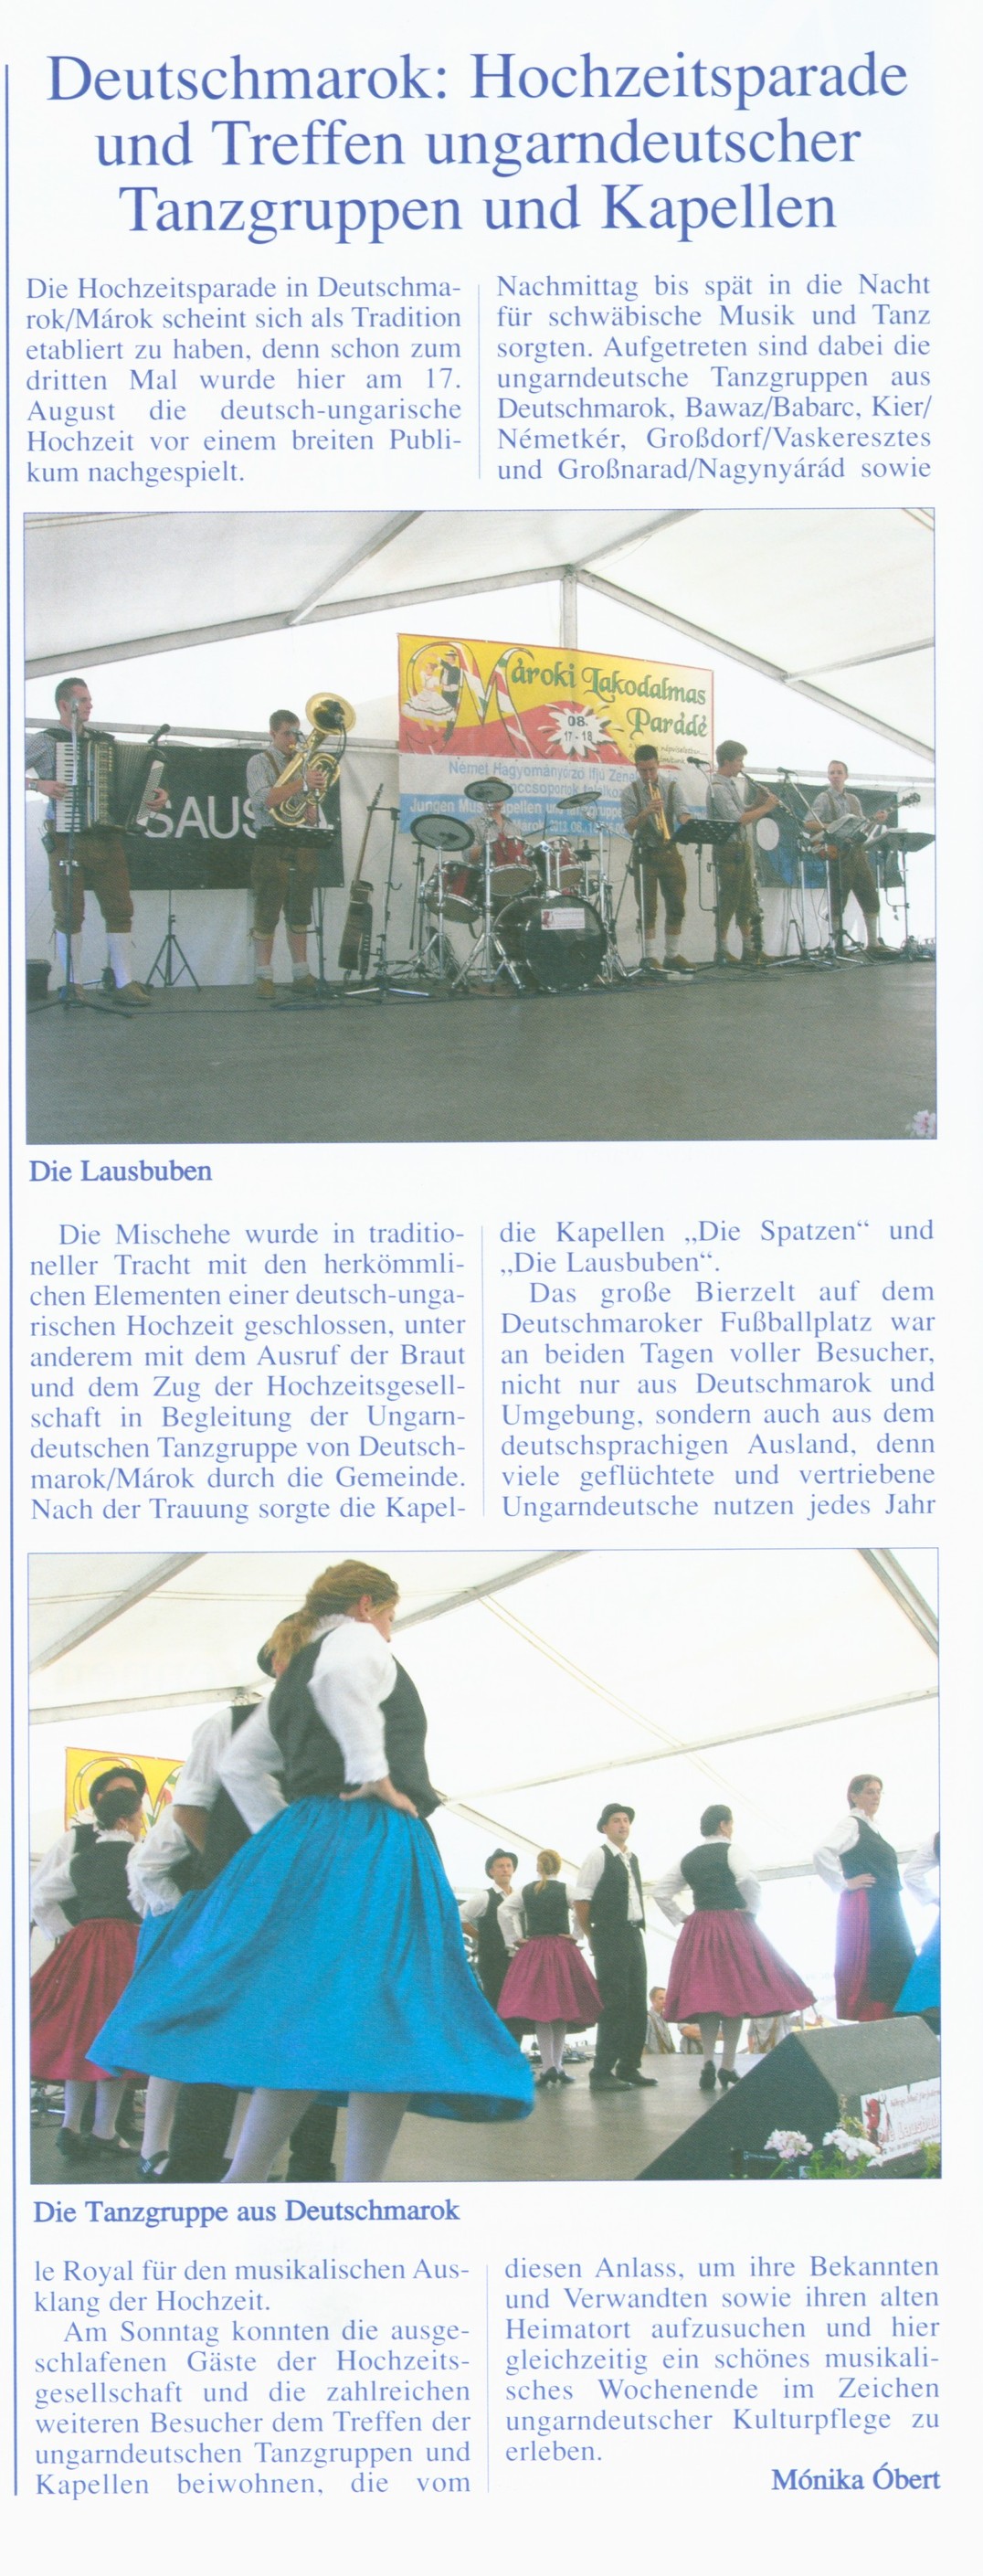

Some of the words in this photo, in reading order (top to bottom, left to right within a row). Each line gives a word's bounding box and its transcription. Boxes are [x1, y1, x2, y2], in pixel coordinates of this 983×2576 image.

[46, 52, 447, 101] Deutschmarok:
[469, 49, 909, 111] Hochzeitsparade
[94, 119, 195, 167] und
[211, 118, 407, 166] Treffen
[424, 116, 862, 178] ungarndeutscher
[118, 186, 464, 246] Tanzgruppen
[481, 183, 582, 231] und
[600, 182, 838, 243] Kapellen
[26, 277, 69, 300] Die
[77, 276, 277, 304] Hochzeitsparade
[286, 276, 309, 298] in
[317, 275, 461, 298] Deutschma-
[496, 304, 534, 327] für
[548, 304, 703, 327] schwäbische
[718, 303, 796, 326] Musik
[812, 303, 857, 325] und
[872, 303, 931, 325] Tanz
[26, 338, 124, 361] etabliert
[134, 344, 162, 360] zu
[173, 337, 251, 363] haben,
[261, 337, 321, 359] denn
[331, 336, 400, 359] schon
[410, 343, 461, 358] zum
[497, 396, 675, 421] Deutschmarok,
[685, 395, 861, 420] Bawaz/Babarc,
[872, 394, 933, 419] Kier/
[26, 429, 134, 452] Hochzeit
[149, 435, 190, 451] vor
[203, 429, 277, 451] einem
[291, 429, 375, 451] breiten
[389, 428, 462, 451] Publi-
[497, 427, 627, 452] Németkér,
[646, 426, 932, 451] Großdorf/Vaskeresztes
[26, 461, 79, 482] kum
[88, 460, 245, 489] nachgespielt.
[497, 458, 544, 481] und
[557, 456, 846, 485] Großnarad/Nagynyárád
[861, 456, 932, 478] sowie
[581, 667, 707, 705] Lakodalmas
[566, 716, 589, 728] 08.
[28, 1159, 73, 1182] Die
[79, 1159, 214, 1182] Lausbuben
[58, 1223, 101, 1246] Die
[115, 1223, 231, 1246] Mischehe
[244, 1222, 319, 1245] wurde
[333, 1222, 355, 1244] in
[368, 1221, 465, 1244] traditio-
[499, 1221, 536, 1243] die
[555, 1220, 665, 1249] Kapellen
[684, 1219, 741, 1246] „Die
[760, 1219, 870, 1247] Spatzen“
[889, 1218, 935, 1241] und
[29, 1254, 99, 1277] neller
[113, 1253, 191, 1276] Tracht
[207, 1253, 248, 1275] mit
[264, 1253, 307, 1275] den
[323, 1252, 465, 1275] herkömmli-
[500, 1251, 556, 1277] „Die
[565, 1250, 720, 1273] Lausbuben“.
[29, 1315, 116, 1337] rischen
[126, 1313, 235, 1336] Hochzeit
[243, 1313, 395, 1342] geschlossen,
[404, 1316, 467, 1335] unter
[501, 1311, 703, 1334] Deutschmaroker
[720, 1310, 872, 1339] Fußballplatz
[890, 1316, 936, 1331] war
[29, 1436, 150, 1459] deutschen
[156, 1436, 298, 1464] Tanzgruppe
[305, 1441, 351, 1458] von
[358, 1435, 466, 1457] Deutsch-
[30, 1467, 196, 1492] marok/Márok
[206, 1466, 276, 1489] durch
[287, 1466, 323, 1489] die
[335, 1465, 466, 1488] Gemeinde.
[501, 1464, 560, 1487] viele
[579, 1463, 714, 1492] geflüchtete
[735, 1463, 779, 1485] und
[798, 1462, 935, 1485] vertriebene
[502, 1494, 699, 1523] Ungarndeutsche
[713, 1498, 795, 1516] nutzen
[806, 1493, 871, 1521] jedes
[884, 1492, 936, 1515] Jahr
[32, 2200, 78, 2223] Die
[84, 2200, 229, 2229] Tanzgruppe
[236, 2205, 278, 2222] aus
[284, 2198, 461, 2222] Deutschmarok
[34, 2260, 55, 2282] le
[62, 2259, 134, 2287] Royal
[142, 2259, 177, 2281] für
[184, 2259, 227, 2281] den
[234, 2257, 407, 2281] musikalischen
[412, 2258, 470, 2280] Aus-
[504, 2256, 583, 2279] diesen
[594, 2256, 684, 2281] Anlass,
[698, 2262, 736, 2278] um
[749, 2255, 796, 2277] ihre
[809, 2254, 939, 2277] Bekannten
[34, 2290, 100, 2318] klang
[109, 2290, 148, 2312] der
[155, 2289, 270, 2312] Hochzeit.
[505, 2317, 631, 2340] Heimatort
[650, 2316, 807, 2339] aufzusuchen
[826, 2316, 872, 2338] und
[891, 2315, 941, 2337] hier
[35, 2350, 167, 2373] schlafenen
[186, 2350, 257, 2372] Gäste
[277, 2349, 318, 2372] der
[335, 2348, 470, 2371] Hochzeits-
[504, 2348, 648, 2377] gleichzeitig
[662, 2347, 700, 2369] ein
[714, 2347, 810, 2369] schönes
[825, 2346, 939, 2369] musikali-
[505, 2379, 574, 2401] sches
[597, 2377, 758, 2401] Wochenende
[783, 2377, 815, 2399] im
[838, 2376, 940, 2399] Zeichen
[35, 2412, 140, 2434] weiteren
[150, 2411, 264, 2433] Besucher
[271, 2411, 324, 2433] dem
[332, 2410, 423, 2433] Treffen
[431, 2410, 471, 2432] der
[505, 2408, 713, 2437] ungarndeutscher
[733, 2407, 892, 2435] Kulturpflege
[911, 2412, 940, 2429] zu
[35, 2442, 242, 2471] ungarndeutschen
[253, 2441, 413, 2469] Tanzgruppen
[426, 2440, 471, 2463] und
[770, 2467, 866, 2491] Mónika
[872, 2461, 942, 2491] Óbert
